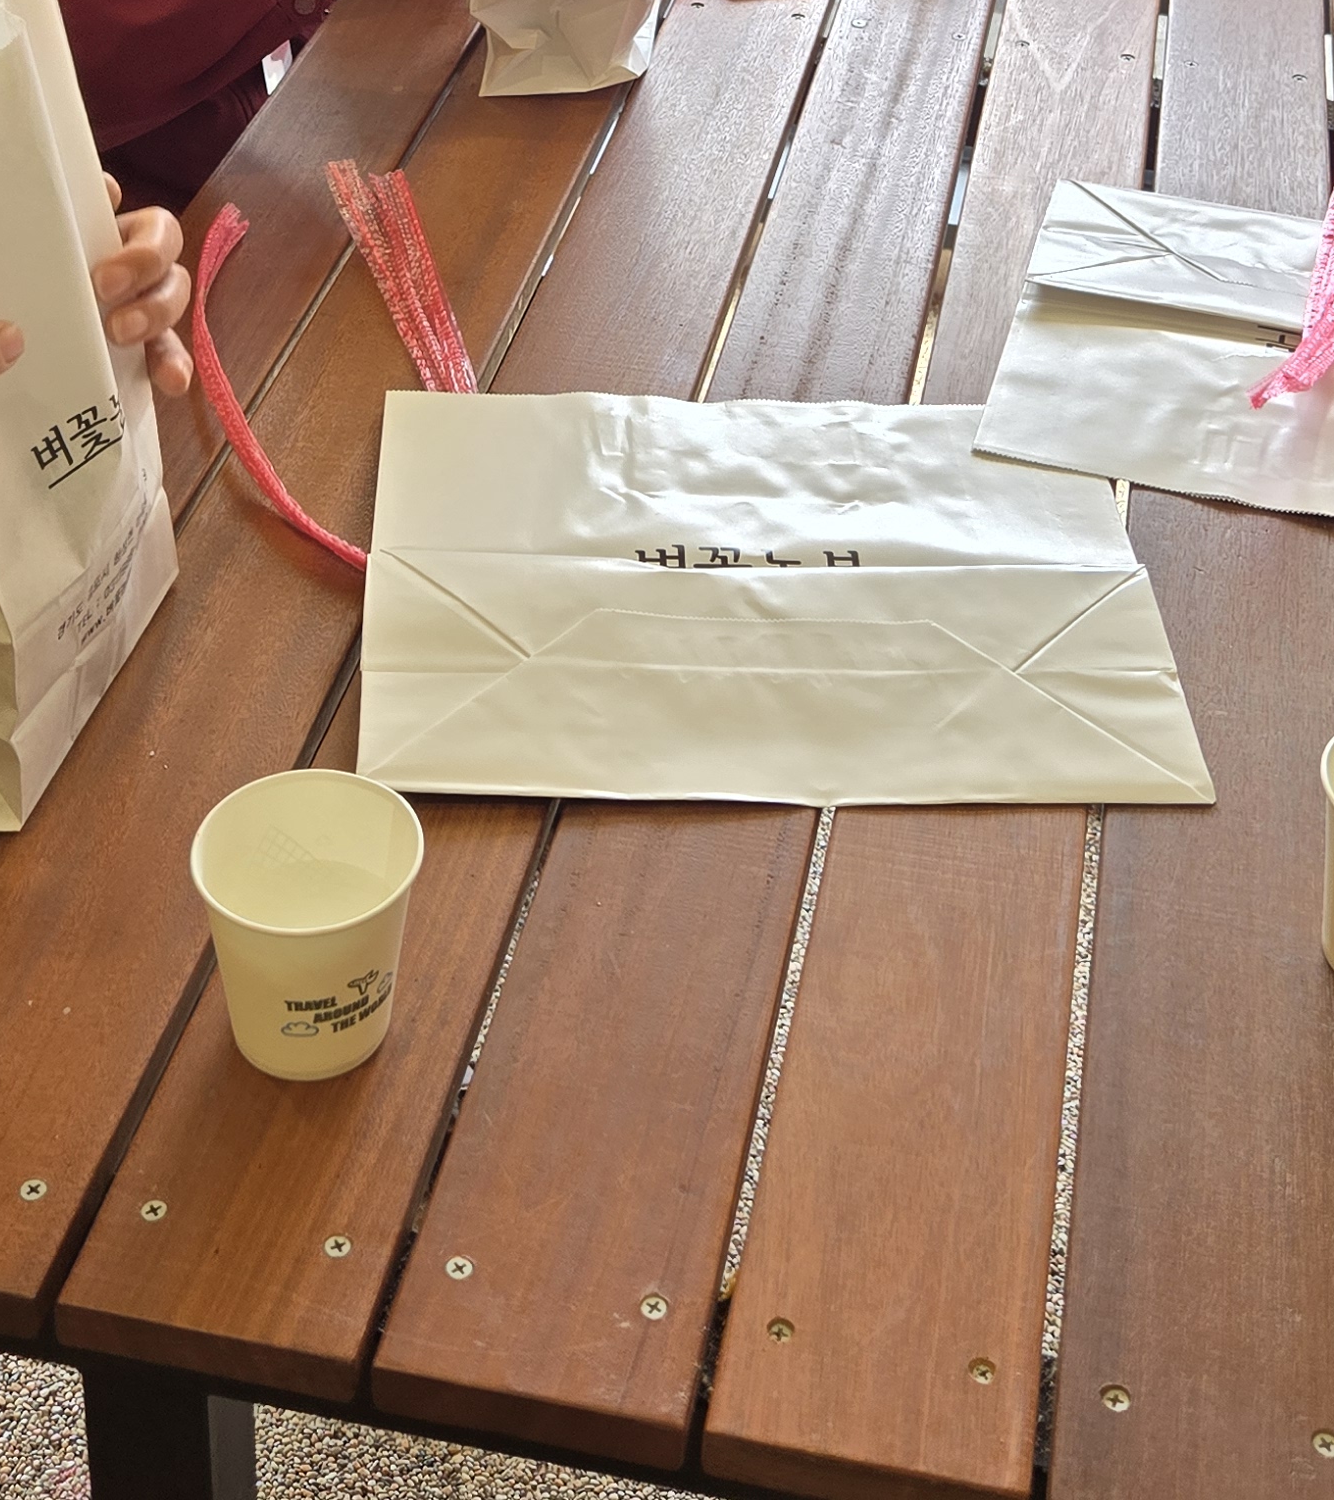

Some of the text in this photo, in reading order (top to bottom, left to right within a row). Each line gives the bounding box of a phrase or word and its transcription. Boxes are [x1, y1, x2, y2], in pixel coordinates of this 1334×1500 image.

[284, 995, 337, 1012] TRAVEL
[313, 994, 370, 1024] AROUND
[330, 1013, 357, 1034] THE
